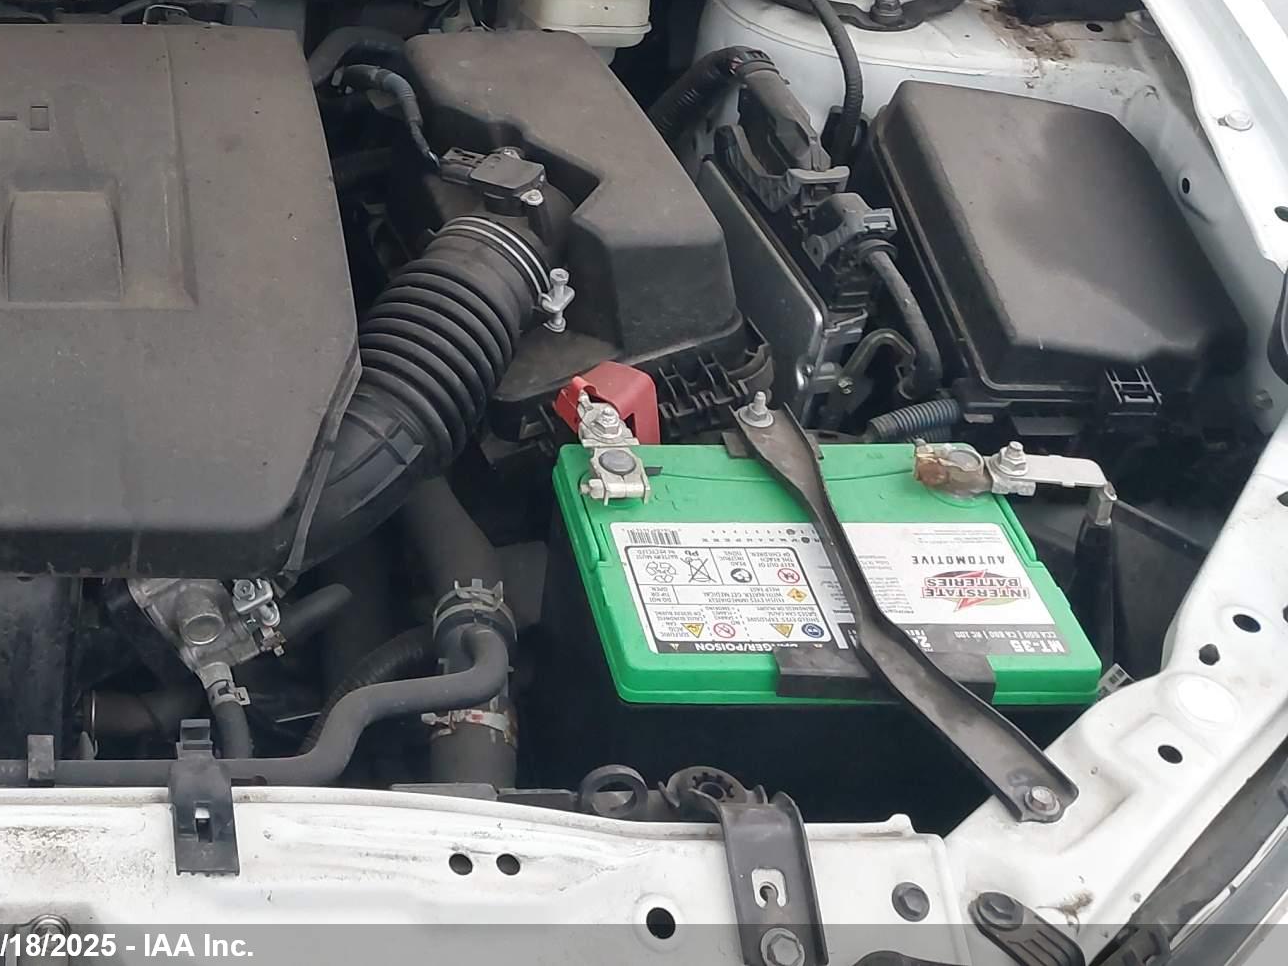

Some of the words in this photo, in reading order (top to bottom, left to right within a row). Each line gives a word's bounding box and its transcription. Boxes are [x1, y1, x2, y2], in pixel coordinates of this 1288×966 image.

[911, 555, 1005, 564] AUTOMOTIVE
[927, 578, 1019, 587] BATTERIES
[924, 588, 1028, 598] INTERSTATE
[1010, 639, 1066, 653] MT-35
